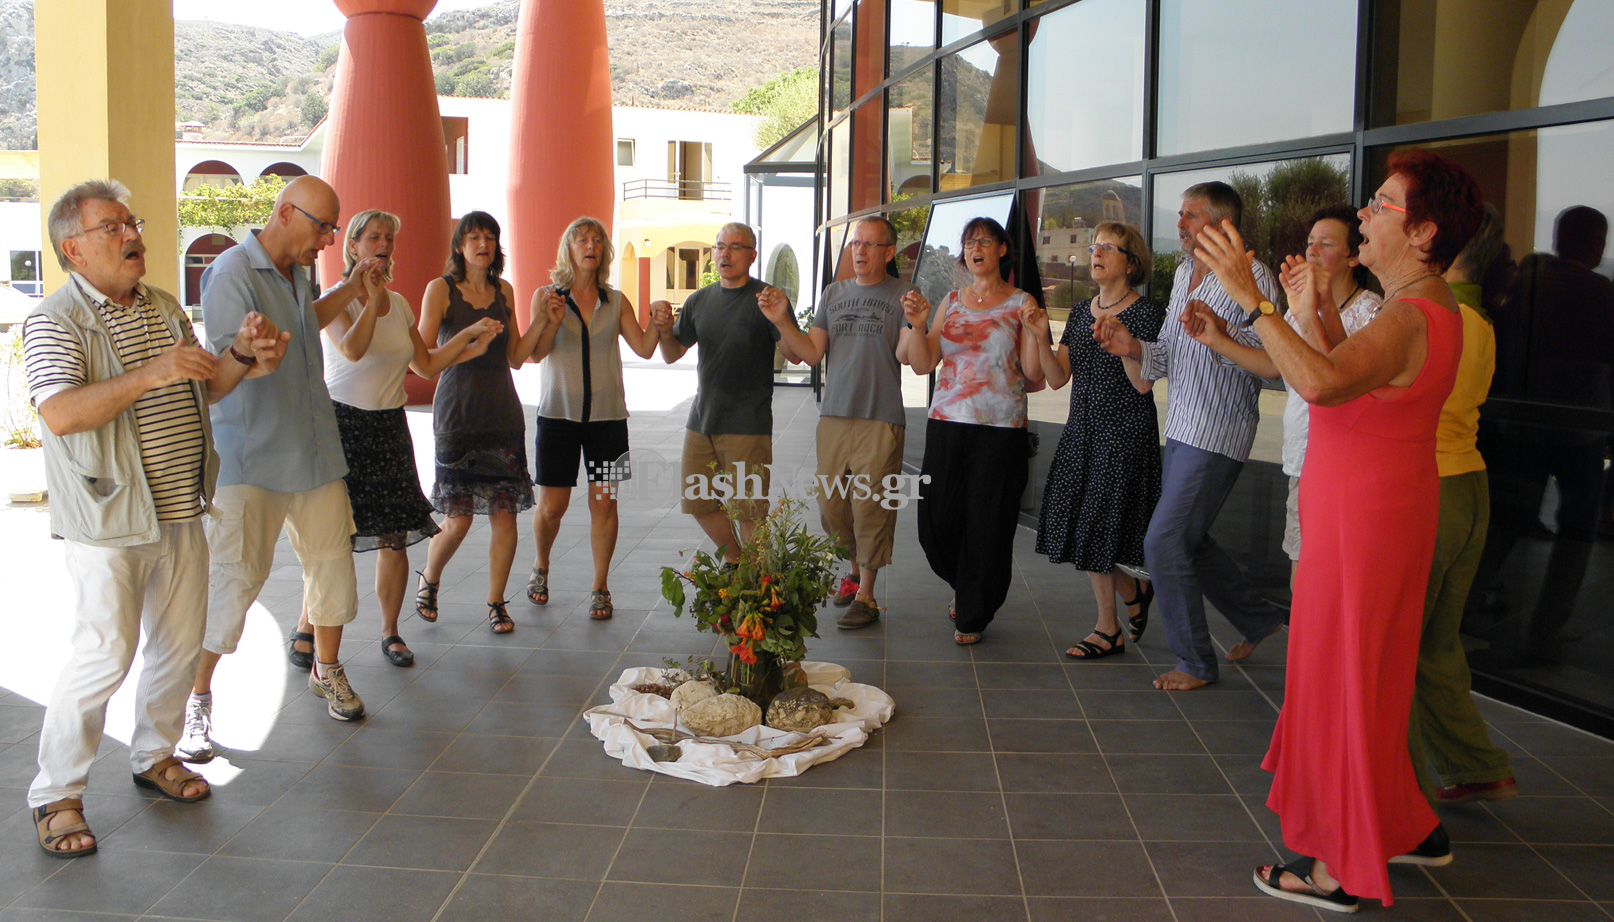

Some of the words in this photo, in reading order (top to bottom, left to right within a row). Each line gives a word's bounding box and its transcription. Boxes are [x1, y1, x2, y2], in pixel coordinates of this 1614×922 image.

[829, 298, 860, 315] SOUTH
[832, 322, 853, 334] FORT
[858, 323, 884, 335] ROCK
